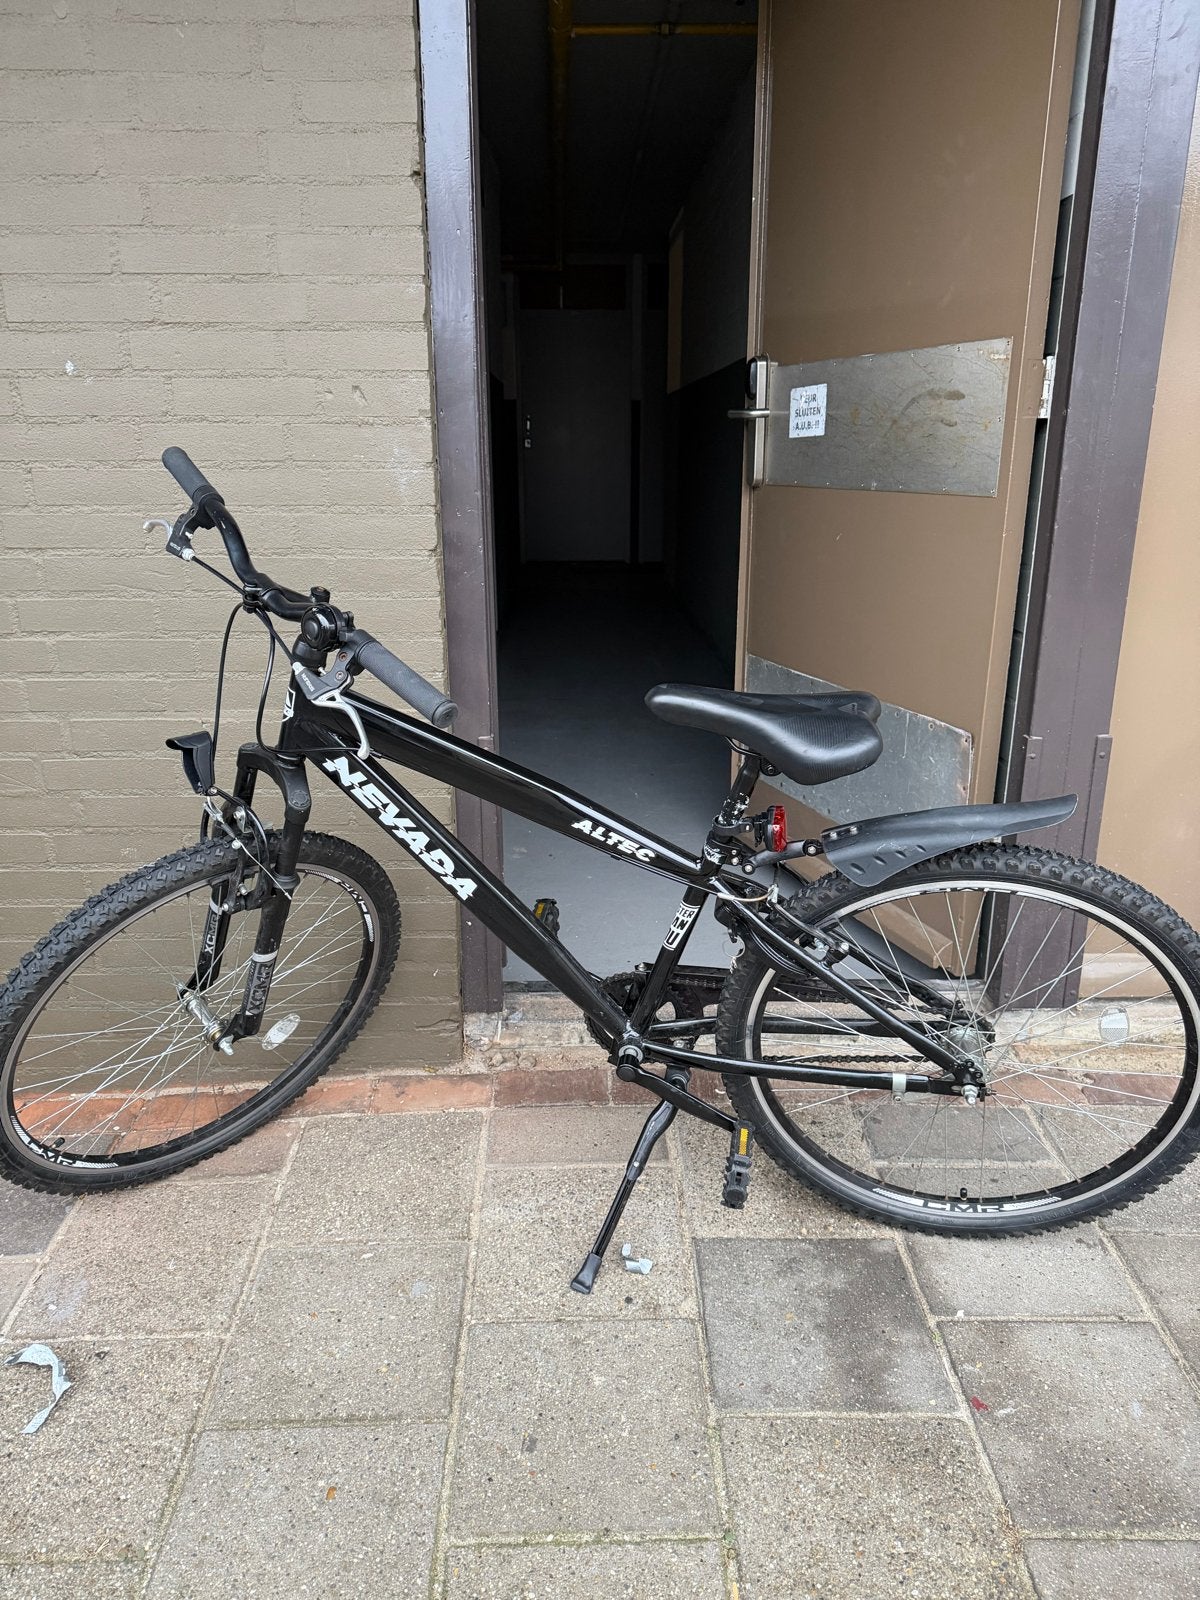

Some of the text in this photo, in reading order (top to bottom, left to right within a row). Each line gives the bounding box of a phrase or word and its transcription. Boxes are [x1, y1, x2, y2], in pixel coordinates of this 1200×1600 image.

[795, 407, 821, 418] SLUITEN
[322, 756, 478, 901] NEVADA
[571, 819, 656, 862] ALTEC
